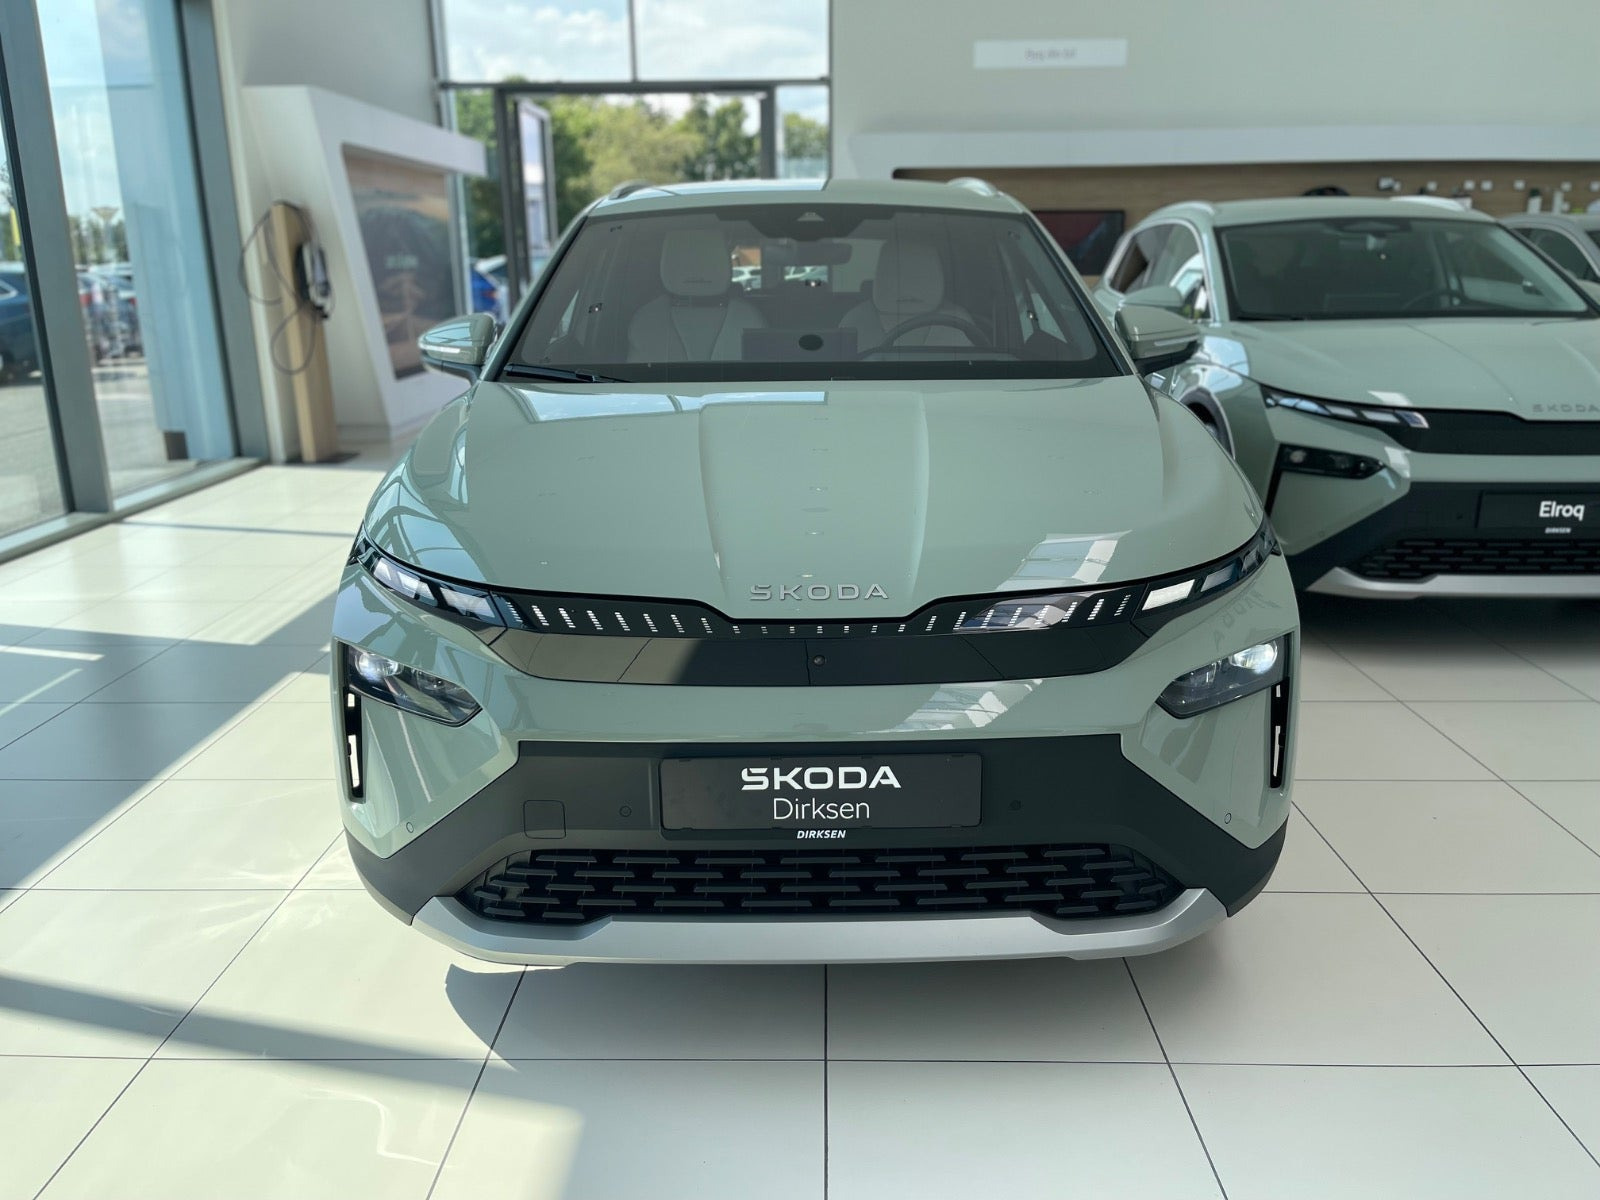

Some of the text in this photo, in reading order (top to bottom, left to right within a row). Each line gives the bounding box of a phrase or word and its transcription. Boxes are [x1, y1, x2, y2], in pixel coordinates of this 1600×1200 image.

[1532, 403, 1600, 413] SKODA
[1539, 501, 1585, 521] Elroq
[749, 583, 889, 600] SKODA
[741, 765, 902, 791] SKODA
[773, 797, 870, 820] Dirksen
[796, 829, 847, 839] DIRKSEN
